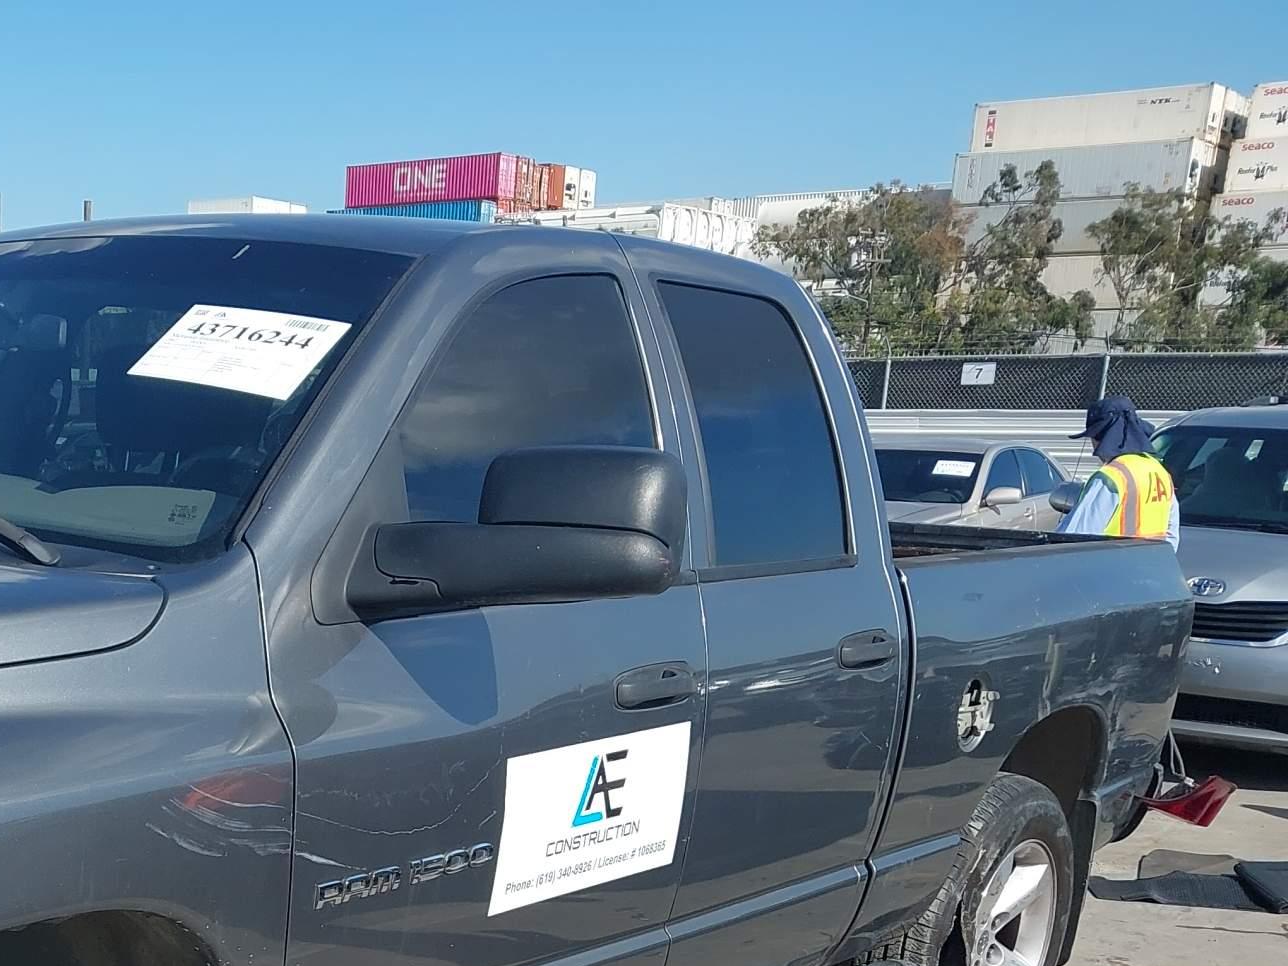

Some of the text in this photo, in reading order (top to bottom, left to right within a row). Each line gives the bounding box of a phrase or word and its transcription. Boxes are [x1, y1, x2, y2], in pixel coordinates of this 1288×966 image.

[1263, 86, 1288, 97] seac
[1241, 142, 1275, 152] seaco
[394, 161, 447, 193] ONE
[1222, 196, 1255, 207] seaco
[187, 321, 314, 349] 43716244
[975, 367, 984, 380] 7
[545, 819, 641, 858] CONSTRUCTION
[313, 842, 495, 911] RAM 1500
[504, 878, 535, 896] Phone:
[535, 868, 556, 889] (619)
[598, 851, 629, 869] License:
